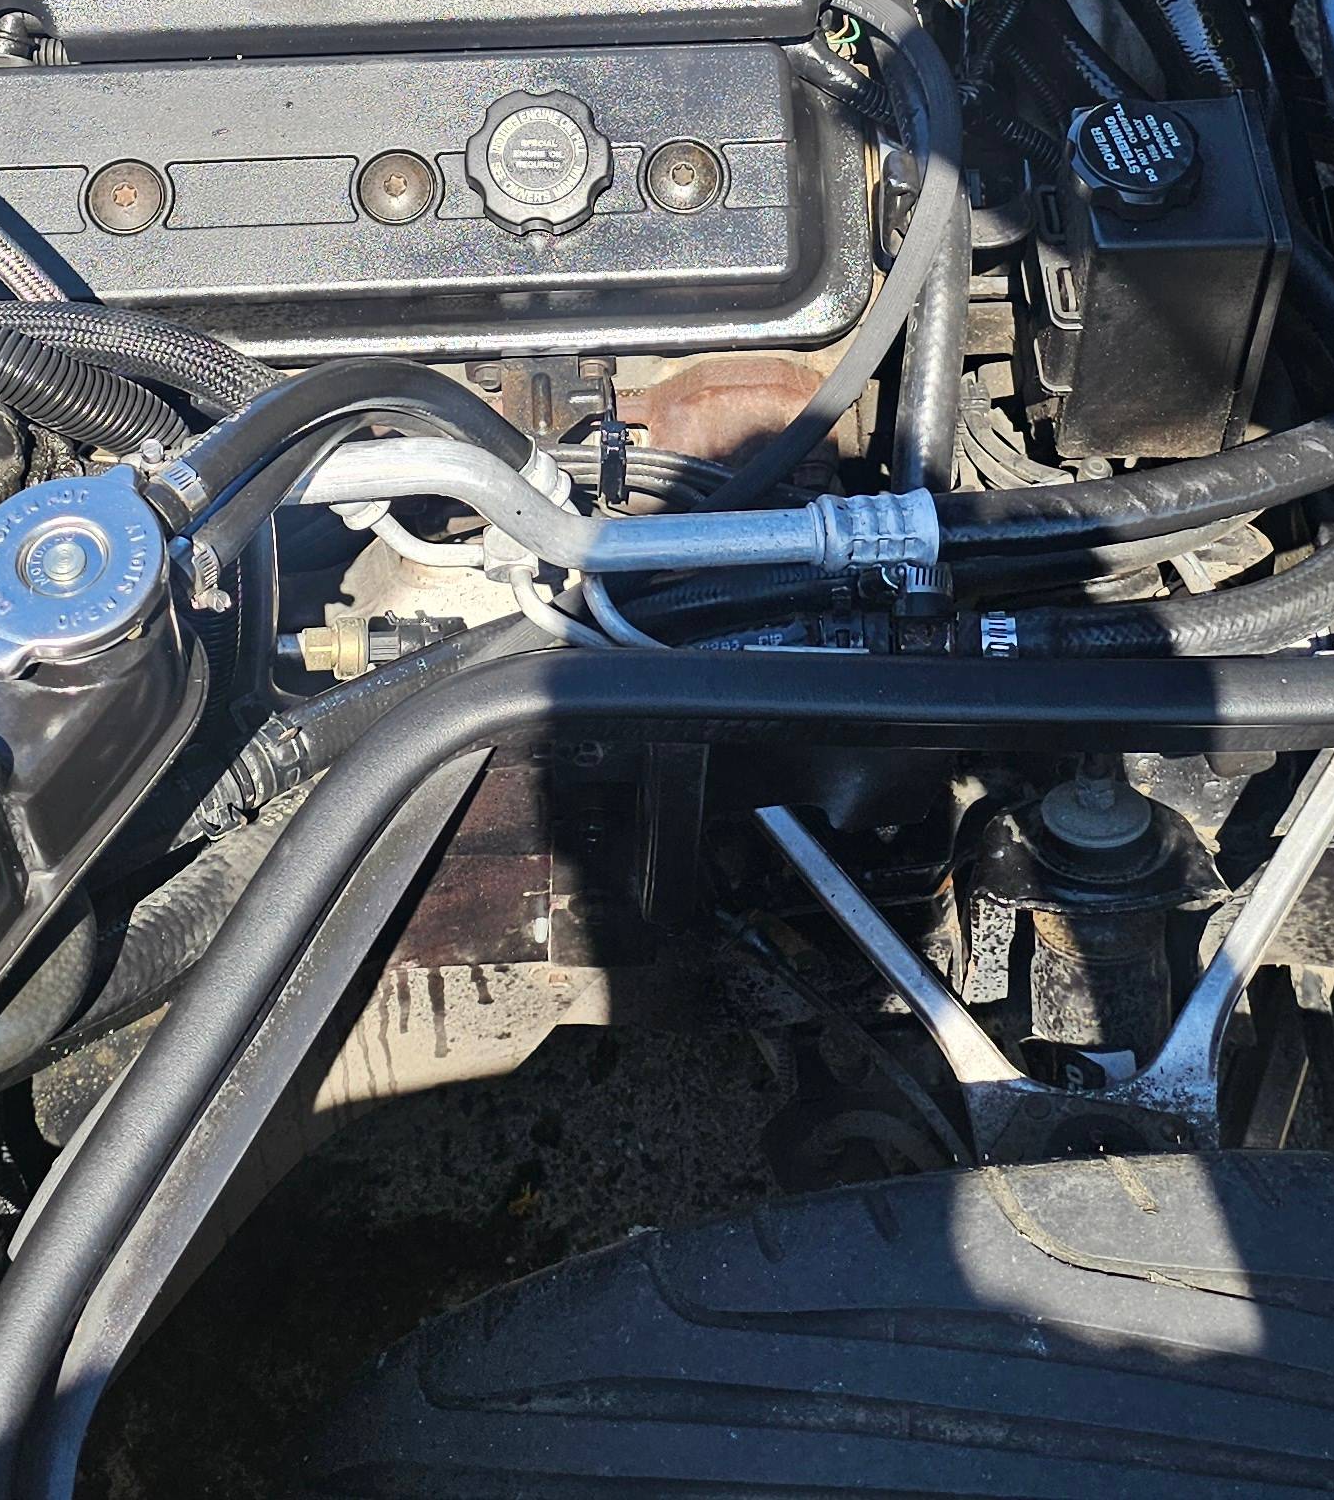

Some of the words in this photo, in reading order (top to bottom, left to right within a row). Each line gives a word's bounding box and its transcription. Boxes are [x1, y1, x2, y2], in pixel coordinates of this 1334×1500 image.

[518, 108, 561, 123] ENGINE
[1113, 103, 1137, 144] OVERFILL
[1133, 118, 1150, 141] ONLY
[1145, 114, 1175, 160] APPROVED
[1163, 121, 1181, 147] FLUID
[1091, 127, 1120, 171] POWER
[1104, 115, 1140, 174] STEERING
[1146, 144, 1161, 162] USE
[1134, 148, 1152, 167] NOT
[1145, 167, 1158, 183] DO
